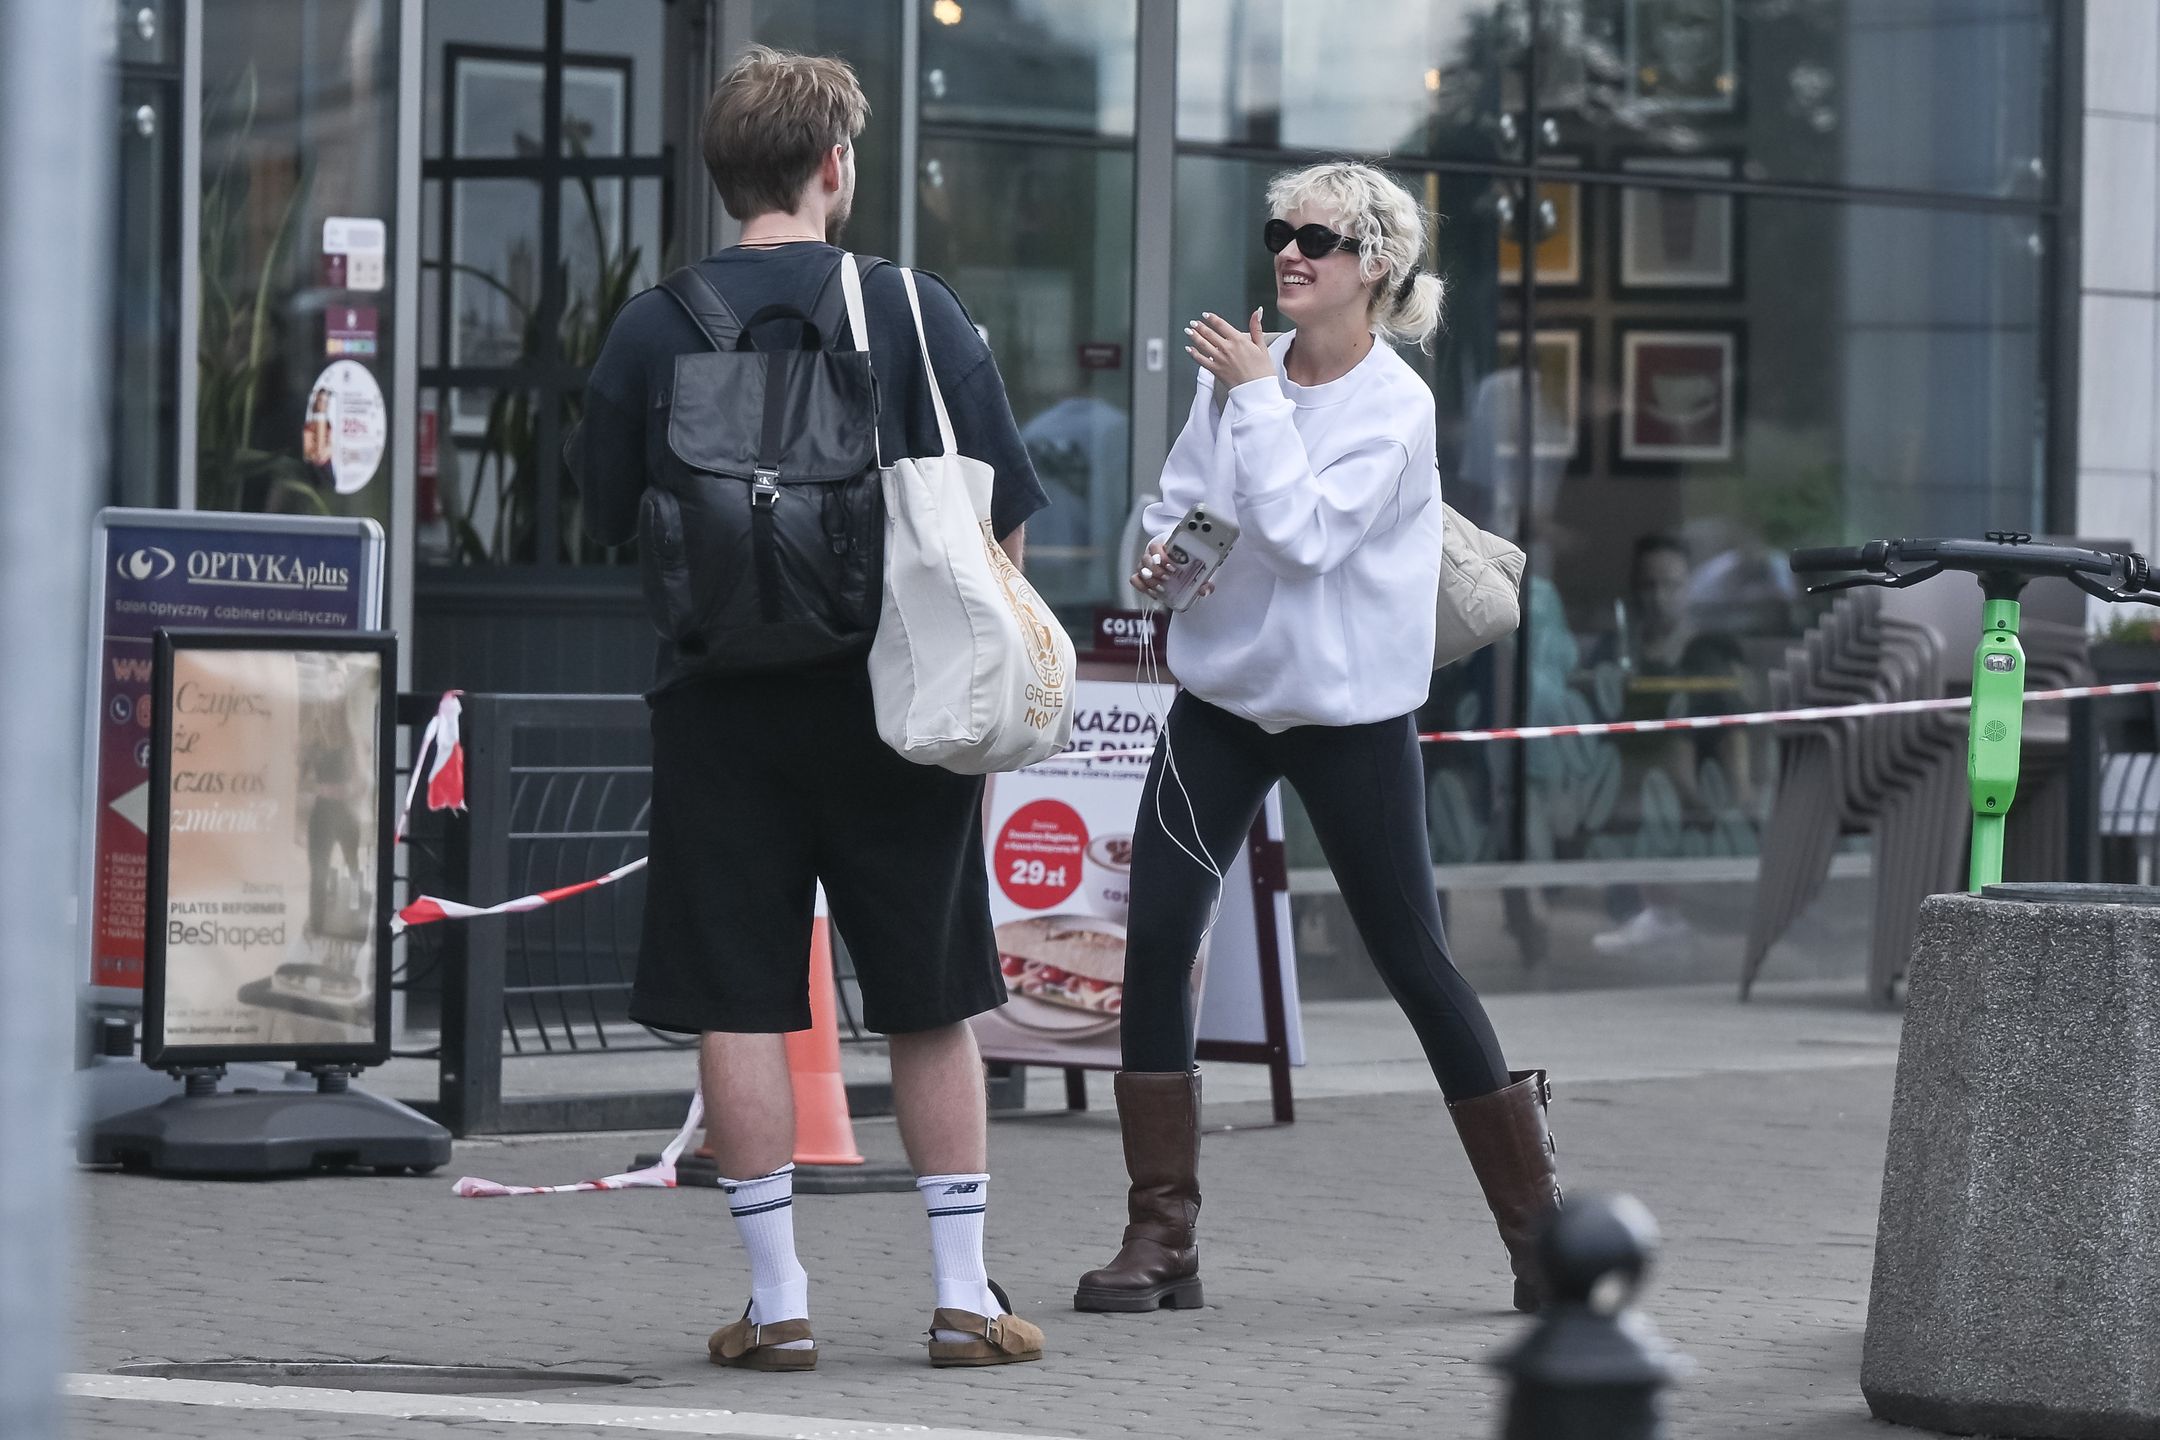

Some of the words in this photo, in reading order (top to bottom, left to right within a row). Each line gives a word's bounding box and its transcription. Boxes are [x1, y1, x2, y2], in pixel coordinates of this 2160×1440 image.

[187, 549, 348, 591] OPTYKAplus
[115, 599, 149, 614] Salon
[149, 602, 209, 620] Optyczny
[267, 607, 348, 626] Okulistyczny
[1103, 617, 1155, 636] COSTA
[173, 770, 226, 794] czas
[170, 901, 219, 914] PILATES
[221, 902, 287, 915] REFORMER
[167, 920, 286, 950] BeShaped
